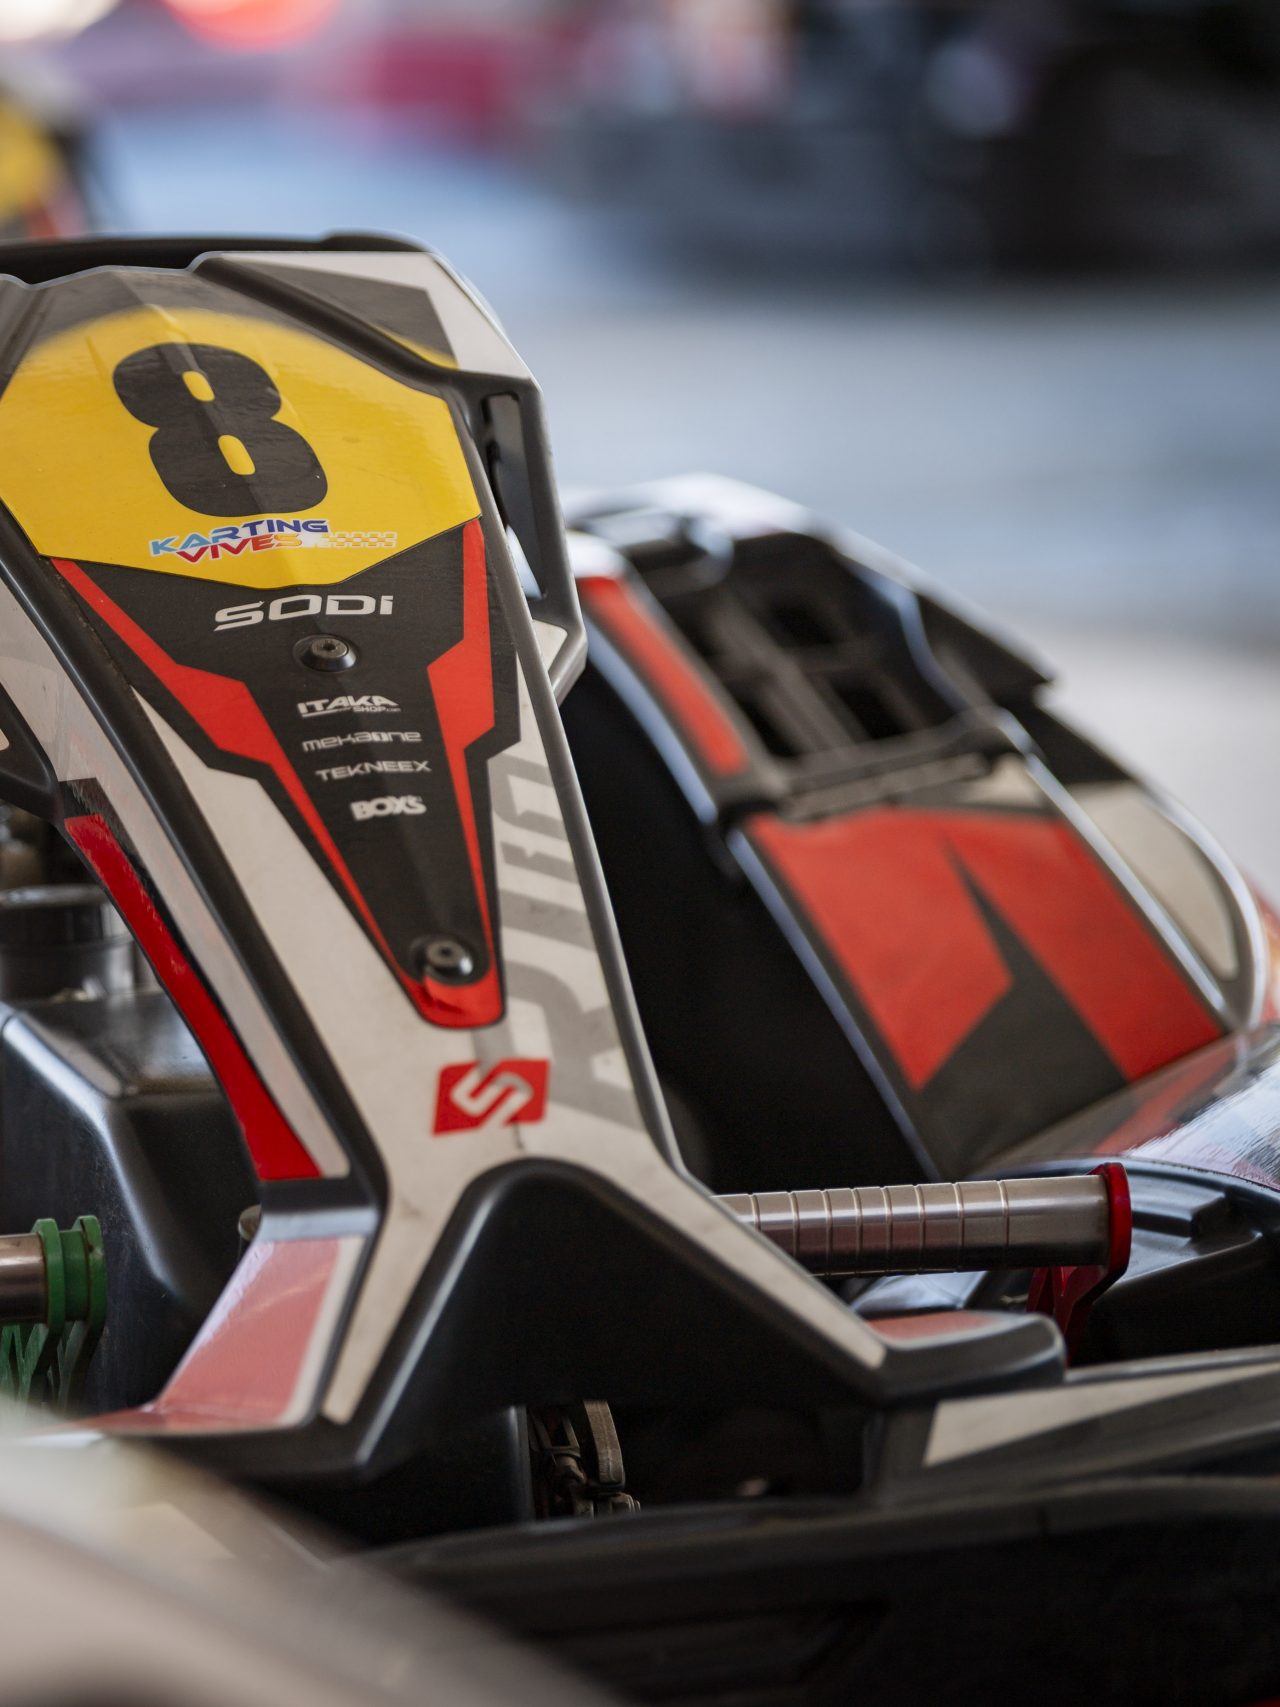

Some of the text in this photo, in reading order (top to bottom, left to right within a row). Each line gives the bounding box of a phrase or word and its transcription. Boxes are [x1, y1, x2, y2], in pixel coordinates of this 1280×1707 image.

[113, 342, 329, 518] 8
[152, 519, 328, 555] KARTING
[176, 534, 303, 563] VIVES
[213, 595, 394, 632] SODI
[297, 695, 399, 714] ITAKA
[315, 760, 432, 782] TEKNEEX
